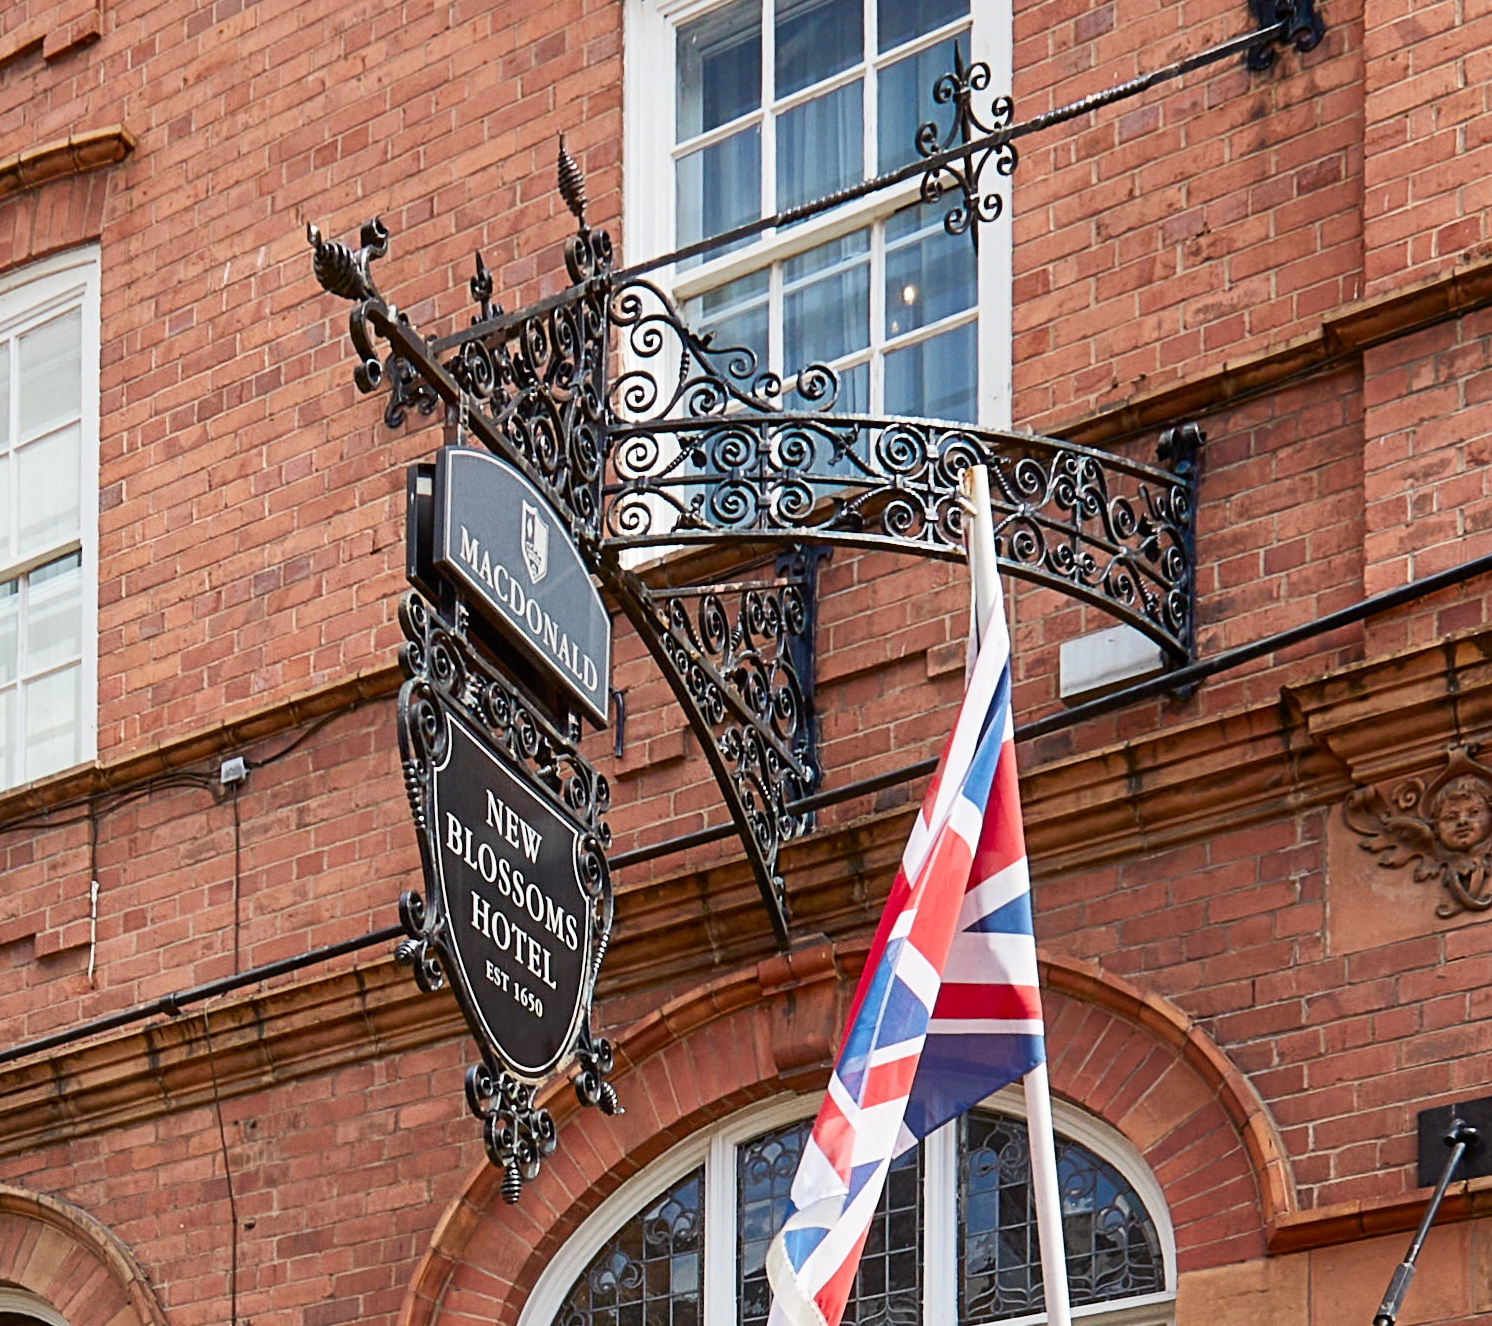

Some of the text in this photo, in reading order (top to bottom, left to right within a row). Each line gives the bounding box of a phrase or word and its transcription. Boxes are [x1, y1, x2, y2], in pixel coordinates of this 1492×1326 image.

[458, 525, 599, 693] MACDONALD
[485, 789, 543, 864] NEW
[445, 811, 580, 952] BLOSSOMS
[470, 890, 557, 991] HOTEL
[484, 963, 544, 1019] EST 1650
